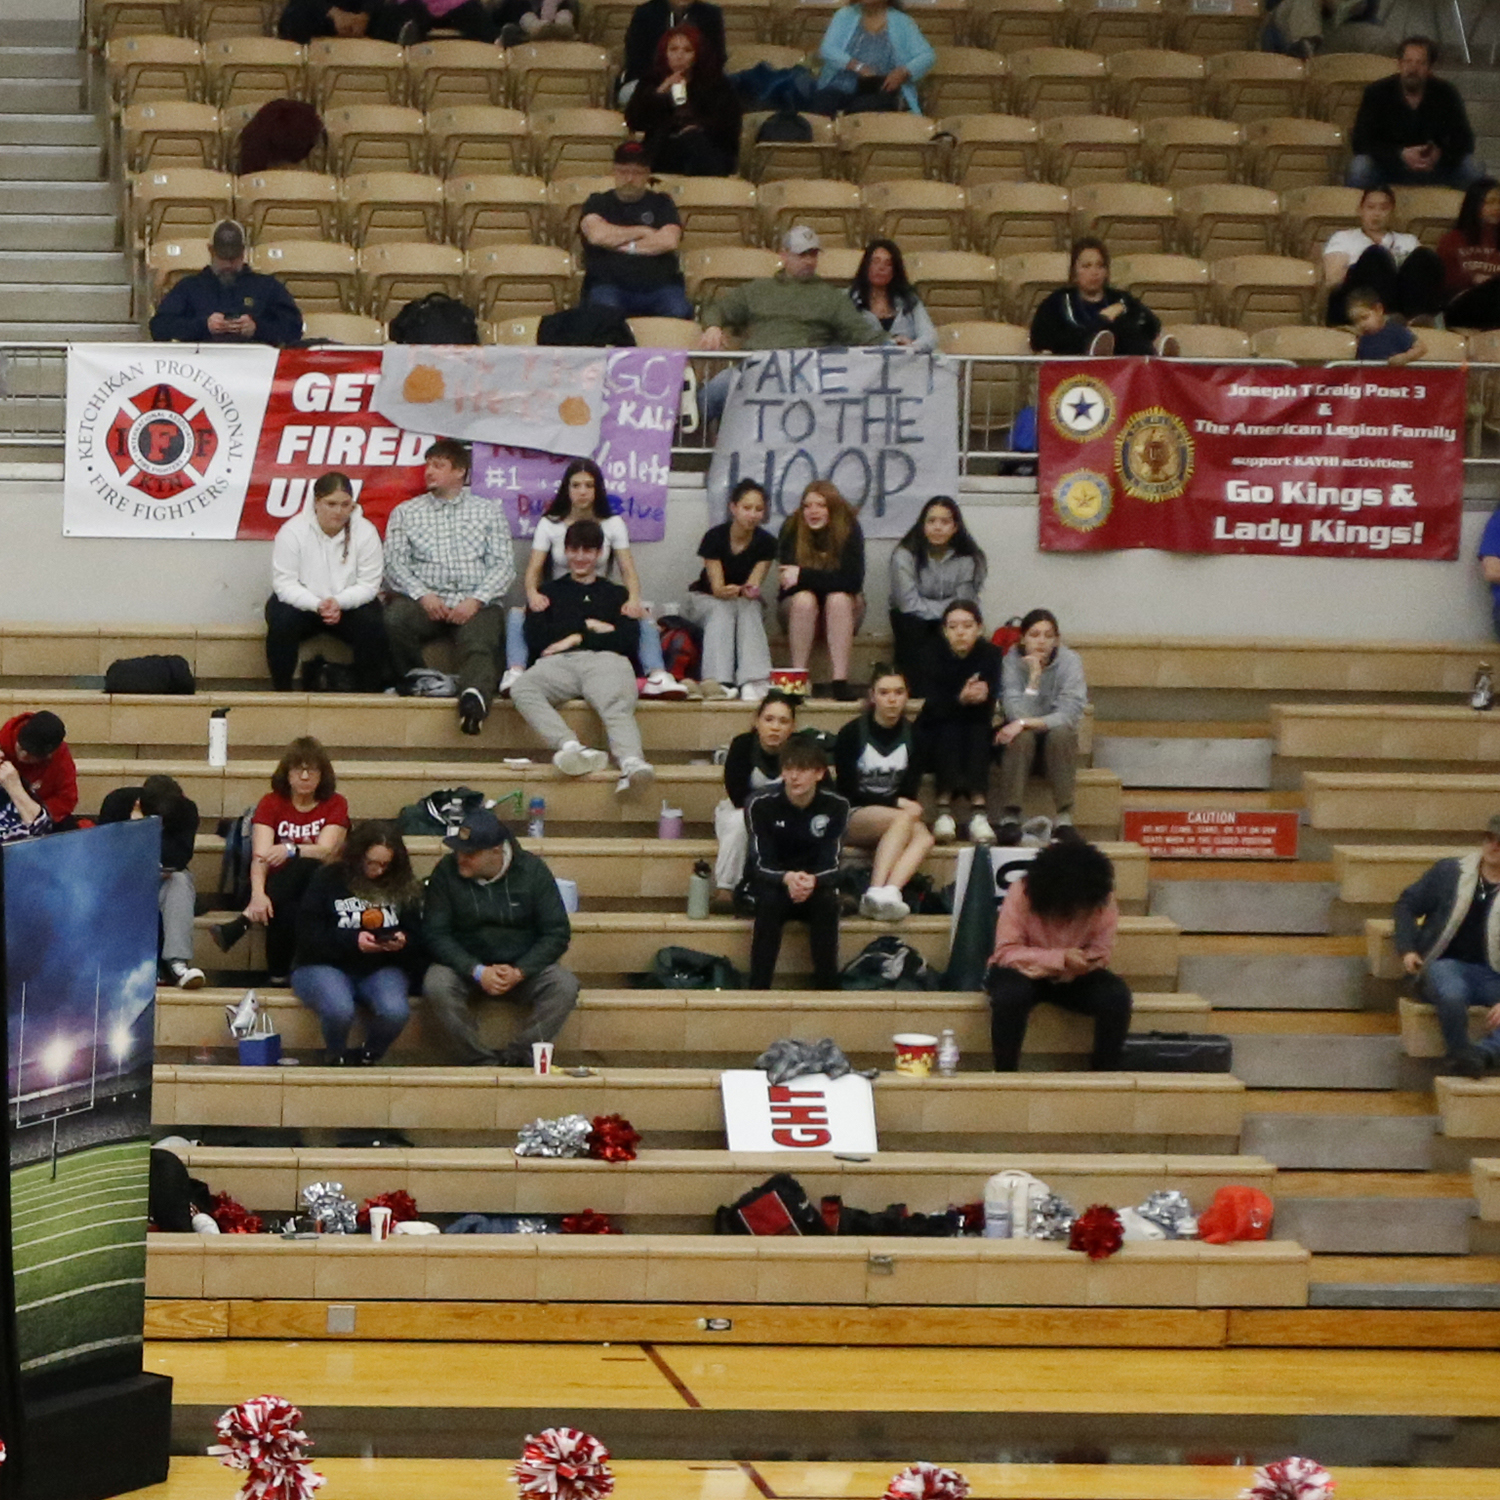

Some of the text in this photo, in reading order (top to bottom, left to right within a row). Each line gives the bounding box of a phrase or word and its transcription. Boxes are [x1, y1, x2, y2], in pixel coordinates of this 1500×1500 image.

[863, 348, 934, 395] IT
[292, 371, 382, 413] GET
[1228, 383, 1427, 399] Joseph T Craig Post 3
[79, 359, 244, 462] KETCHIKAN PROFESSIONAL
[744, 394, 924, 445] TO THE
[1318, 402, 1332, 416] &
[148, 423, 179, 461] F
[276, 424, 437, 466] FIRED
[1195, 419, 1457, 442] The American Legion Family
[484, 466, 522, 490] #1
[1232, 457, 1291, 468] support
[1341, 457, 1414, 469] activities:
[90, 474, 230, 521] FIRE FIGHTERS
[728, 448, 917, 524] HOOP
[1226, 480, 1418, 512] Go Kings &
[1214, 516, 1425, 550] Lady Kings!
[278, 818, 326, 838] CHEE
[1187, 812, 1236, 824] CAUTION
[337, 907, 399, 929] MM
[767, 1085, 832, 1148] GHT
